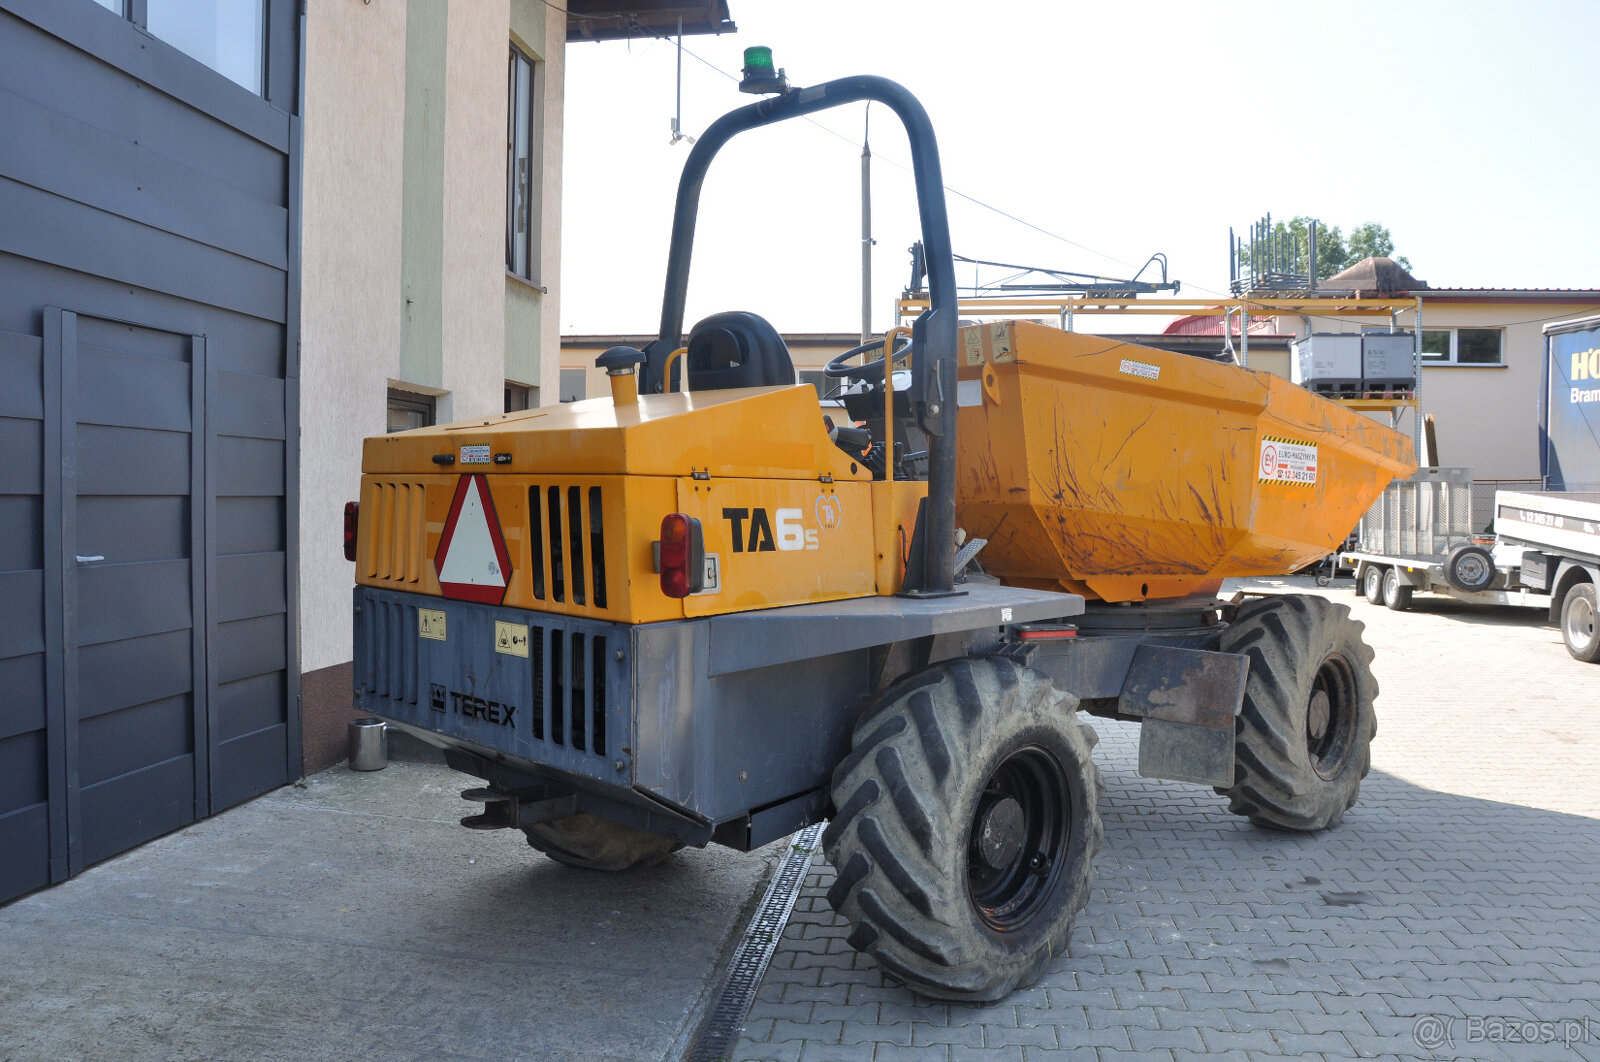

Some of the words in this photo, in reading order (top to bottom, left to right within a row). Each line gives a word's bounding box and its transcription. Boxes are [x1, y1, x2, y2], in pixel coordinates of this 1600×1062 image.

[1285, 470, 1291, 479] 12
[1292, 470, 1301, 480] 345
[1302, 471, 1308, 480] 21
[1309, 473, 1315, 481] 60
[450, 691, 516, 729] TEREX
